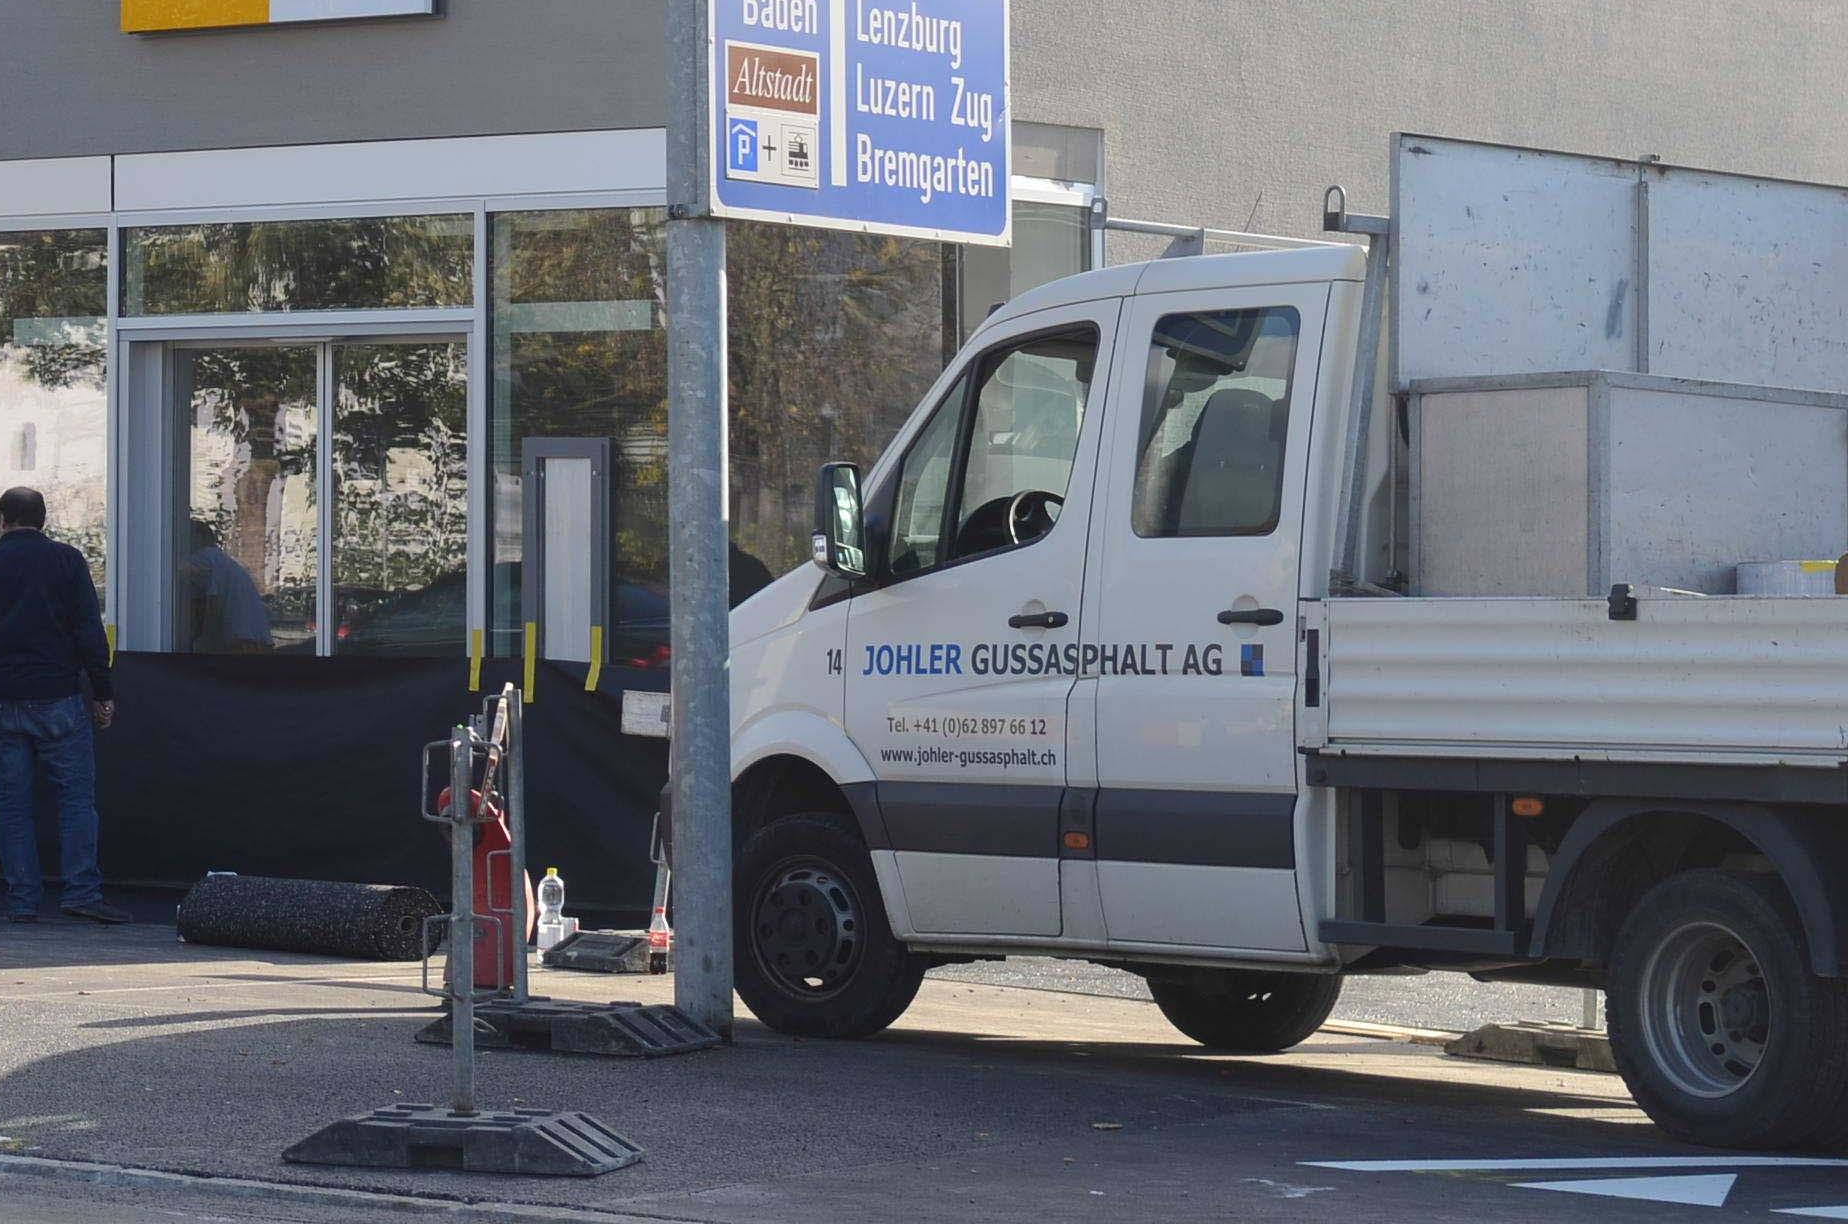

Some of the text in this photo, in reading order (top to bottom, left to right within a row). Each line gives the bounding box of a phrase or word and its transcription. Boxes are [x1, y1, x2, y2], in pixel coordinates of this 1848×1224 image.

[733, 56, 813, 104] Altstadt
[857, 63, 993, 143] Luzern Zug
[857, 134, 993, 205] Bremgarten
[827, 648, 843, 676] 14
[862, 643, 1223, 676] JOHLER GUSSASPHALT AG
[887, 716, 909, 733] Tel.
[913, 718, 938, 734] +41
[981, 719, 1007, 736] 897
[1009, 718, 1026, 735] 66
[1029, 718, 1047, 736] 12
[880, 746, 1057, 770] www.johler-gussasphalt.ch
